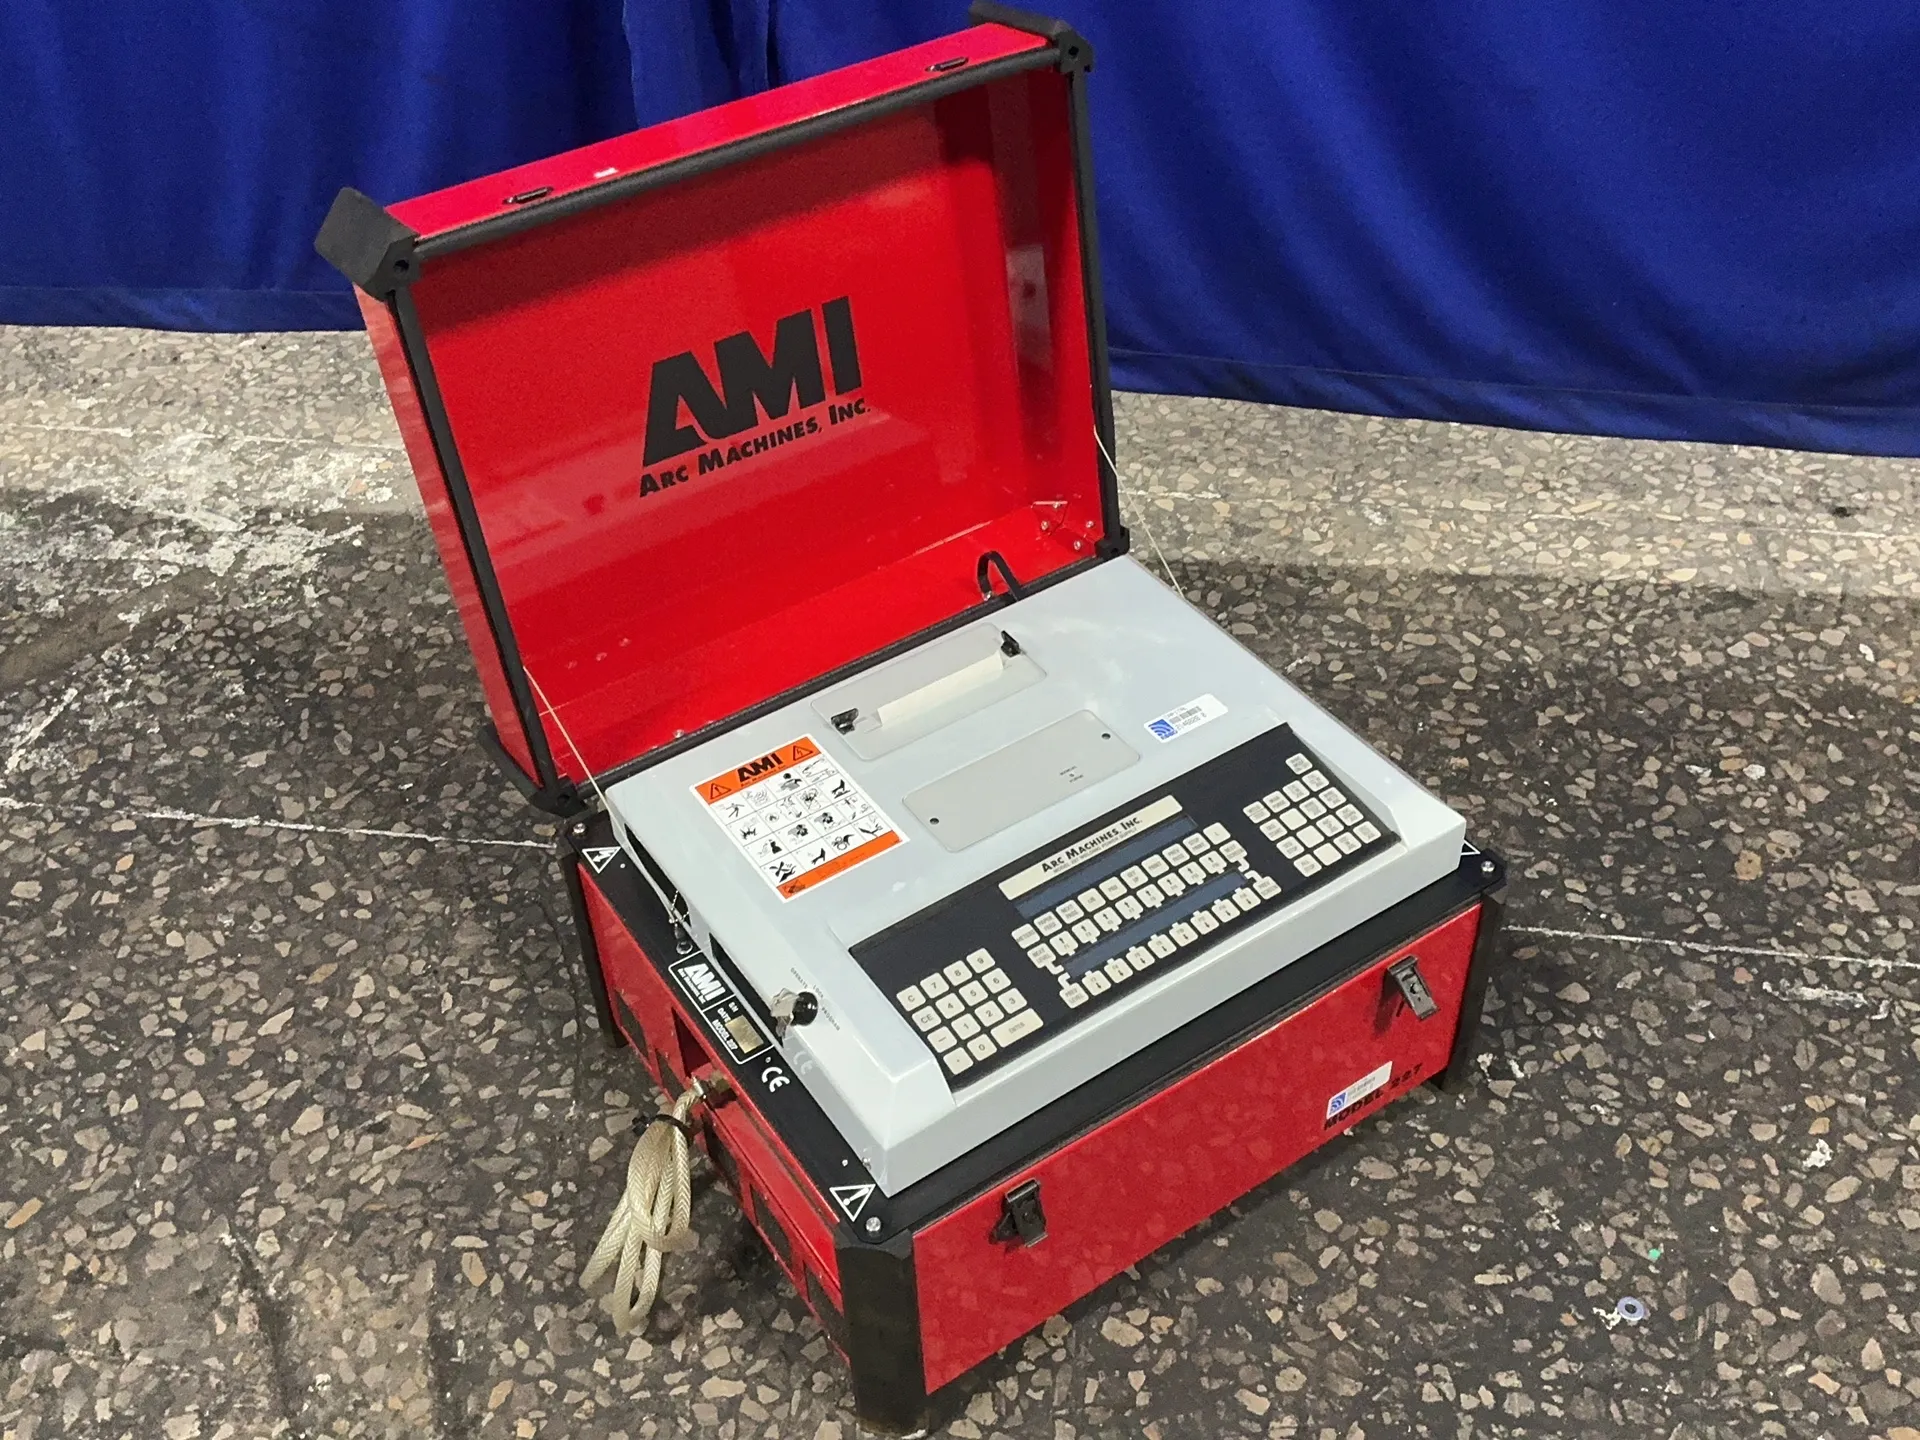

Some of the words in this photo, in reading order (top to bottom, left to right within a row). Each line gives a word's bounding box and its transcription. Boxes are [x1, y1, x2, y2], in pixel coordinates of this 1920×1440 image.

[643, 295, 862, 468] AMI
[639, 465, 689, 498] ARC
[698, 417, 822, 476] MACHINES,
[828, 398, 871, 426] INC.
[737, 752, 783, 782] AMI
[1041, 857, 1065, 873] ARC
[683, 963, 726, 1001] AMI
[954, 969, 962, 977] 8
[1009, 997, 1016, 1005] 3
[717, 1007, 732, 1023] DATE
[920, 1013, 934, 1024] CE
[712, 1019, 730, 1041] MODEL
[761, 1066, 790, 1093] CE
